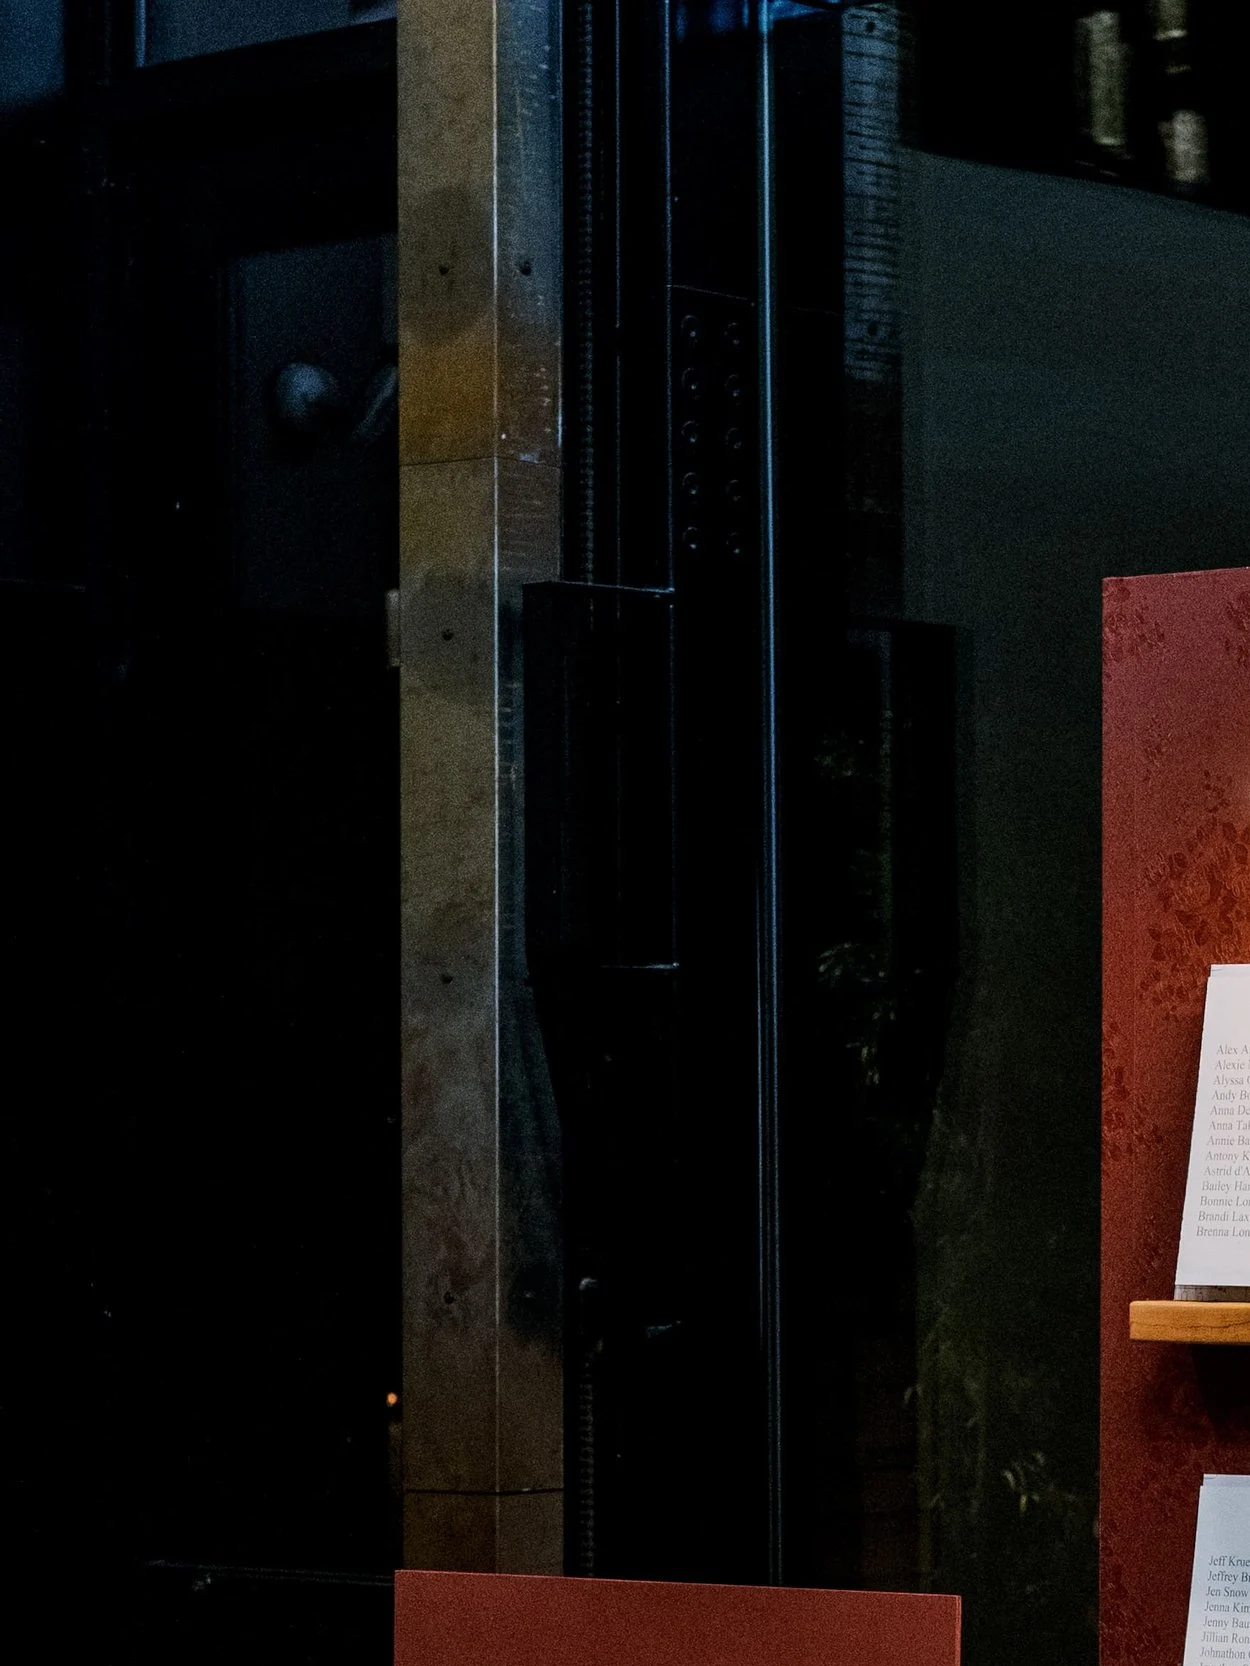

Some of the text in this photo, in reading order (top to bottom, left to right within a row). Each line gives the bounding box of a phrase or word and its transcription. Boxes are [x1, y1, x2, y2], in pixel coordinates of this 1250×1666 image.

[1216, 1045, 1238, 1055] Alex
[1207, 1136, 1235, 1146] Annie
[1198, 1211, 1229, 1222] Brandi
[1196, 1226, 1229, 1237] Brenna
[1209, 1556, 1227, 1568] Jeff
[1207, 1571, 1239, 1584] Jeffrey
[1206, 1587, 1221, 1597] Jen
[1223, 1587, 1248, 1597] Snow
